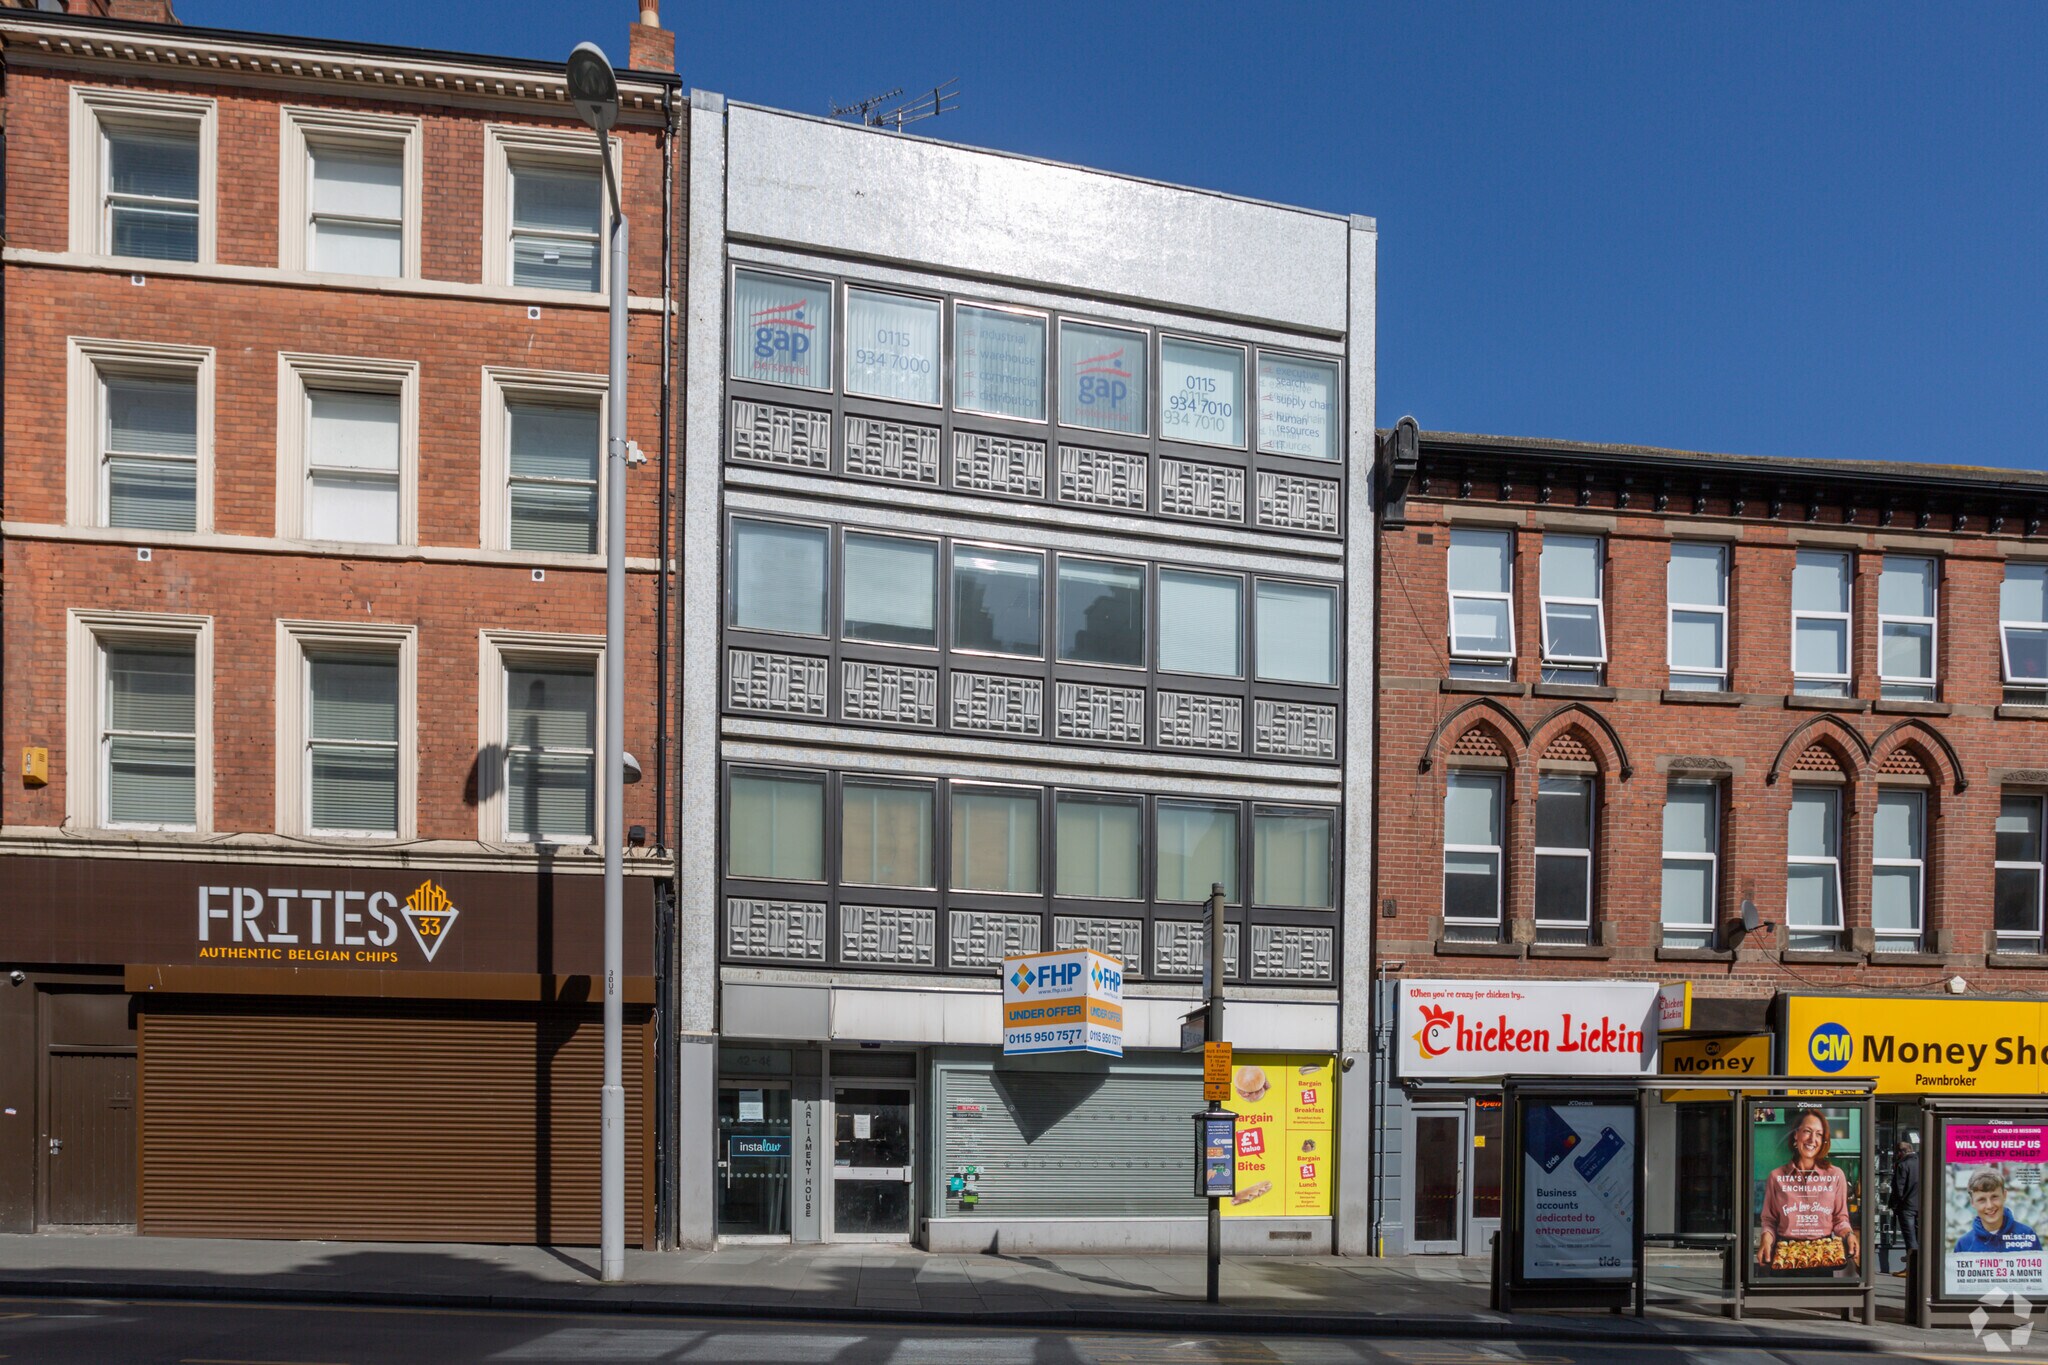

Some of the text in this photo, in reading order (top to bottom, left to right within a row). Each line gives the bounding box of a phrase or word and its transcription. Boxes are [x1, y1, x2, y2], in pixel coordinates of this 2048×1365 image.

[878, 329, 910, 347] 0115
[980, 329, 1026, 345] industrial
[755, 328, 810, 362] gap
[856, 350, 930, 374] 934 7000
[979, 350, 1035, 366] warehouse
[754, 360, 809, 376] personnel
[1275, 366, 1320, 380] executive
[979, 371, 1038, 387] commercial
[1186, 375, 1216, 392] 0115
[1276, 377, 1306, 388] search
[979, 391, 1038, 407] distribution
[1078, 375, 1127, 408] gap
[1170, 395, 1232, 417] 934 7010
[1276, 395, 1333, 411] supply chain
[1276, 411, 1307, 425] human
[1277, 424, 1320, 437] resources
[199, 886, 398, 947] FRITES
[419, 916, 441, 936] 33
[199, 947, 398, 963] AUTHENTIC BELGIAN CHIPS
[1038, 962, 1082, 988] FHP
[1104, 968, 1121, 992] FHP
[1410, 989, 1432, 999] When
[1432, 989, 1455, 999] you're
[1455, 991, 1474, 1000] crazy
[1475, 990, 1485, 999] for
[1486, 990, 1510, 999] chicken
[1658, 997, 1684, 1011] Chicken
[1009, 1005, 1082, 1021] UNDER OFFER
[1090, 1007, 1121, 1022] UNDER OFFER
[1662, 1010, 1682, 1020] Lickin
[1009, 1029, 1082, 1044] 0115 950 7577
[1089, 1031, 1122, 1046] 0115 950 7577
[1421, 1013, 1644, 1056] Chicken Lickin
[1812, 1034, 1850, 1061] CM
[1863, 1035, 1988, 1072] Money
[1674, 1056, 1755, 1073] Money
[1298, 1080, 1322, 1088] Bargain
[1916, 1074, 1977, 1087] Pawnbroker
[1303, 1090, 1314, 1099] £1
[739, 1138, 782, 1152] instalaw
[1241, 1131, 1259, 1146] £1
[1241, 1145, 1261, 1153] Value
[1238, 1162, 1266, 1171] Bites
[1545, 1154, 1561, 1169] tide
[1302, 1165, 1313, 1174] £1
[1536, 1188, 1577, 1197] Business
[1536, 1201, 1579, 1210] accounts
[1782, 1203, 1797, 1216] Food
[1536, 1213, 1595, 1222] dedicated to
[1796, 1214, 1819, 1222] TESCO
[1535, 1226, 1600, 1236] entrepreneurs
[2005, 1240, 2033, 1248] people
[1598, 1256, 1621, 1267] tide
[1957, 1260, 1973, 1268] TEXT
[2016, 1258, 2042, 1267] 70140
[1967, 1269, 1994, 1277] DONATE
[1996, 1268, 2007, 1277] £3
[2010, 1269, 2015, 1277] A
[2017, 1269, 2042, 1277] MONTH
